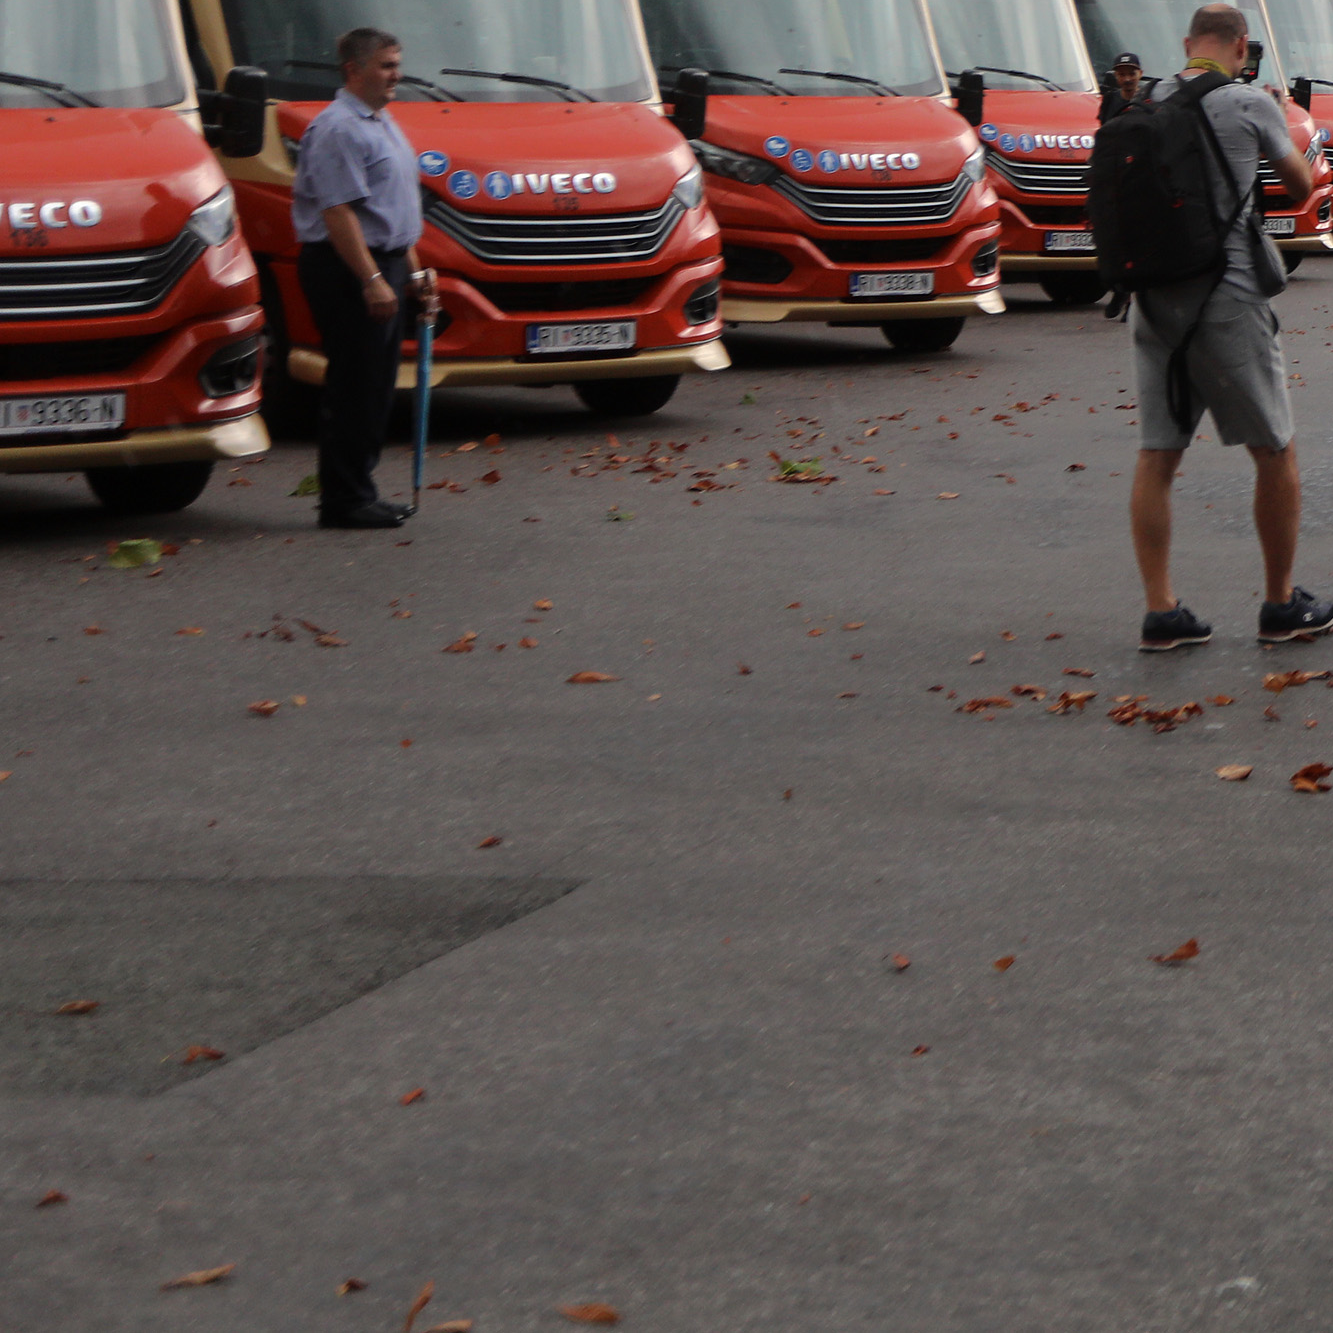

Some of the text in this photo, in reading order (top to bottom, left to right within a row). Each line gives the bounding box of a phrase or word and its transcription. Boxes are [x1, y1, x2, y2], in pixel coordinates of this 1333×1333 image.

[1034, 134, 1095, 149] IVECO
[839, 152, 920, 171] IVECO
[511, 172, 617, 195] IVECO
[0, 200, 102, 229] ECO
[539, 327, 559, 347] RI
